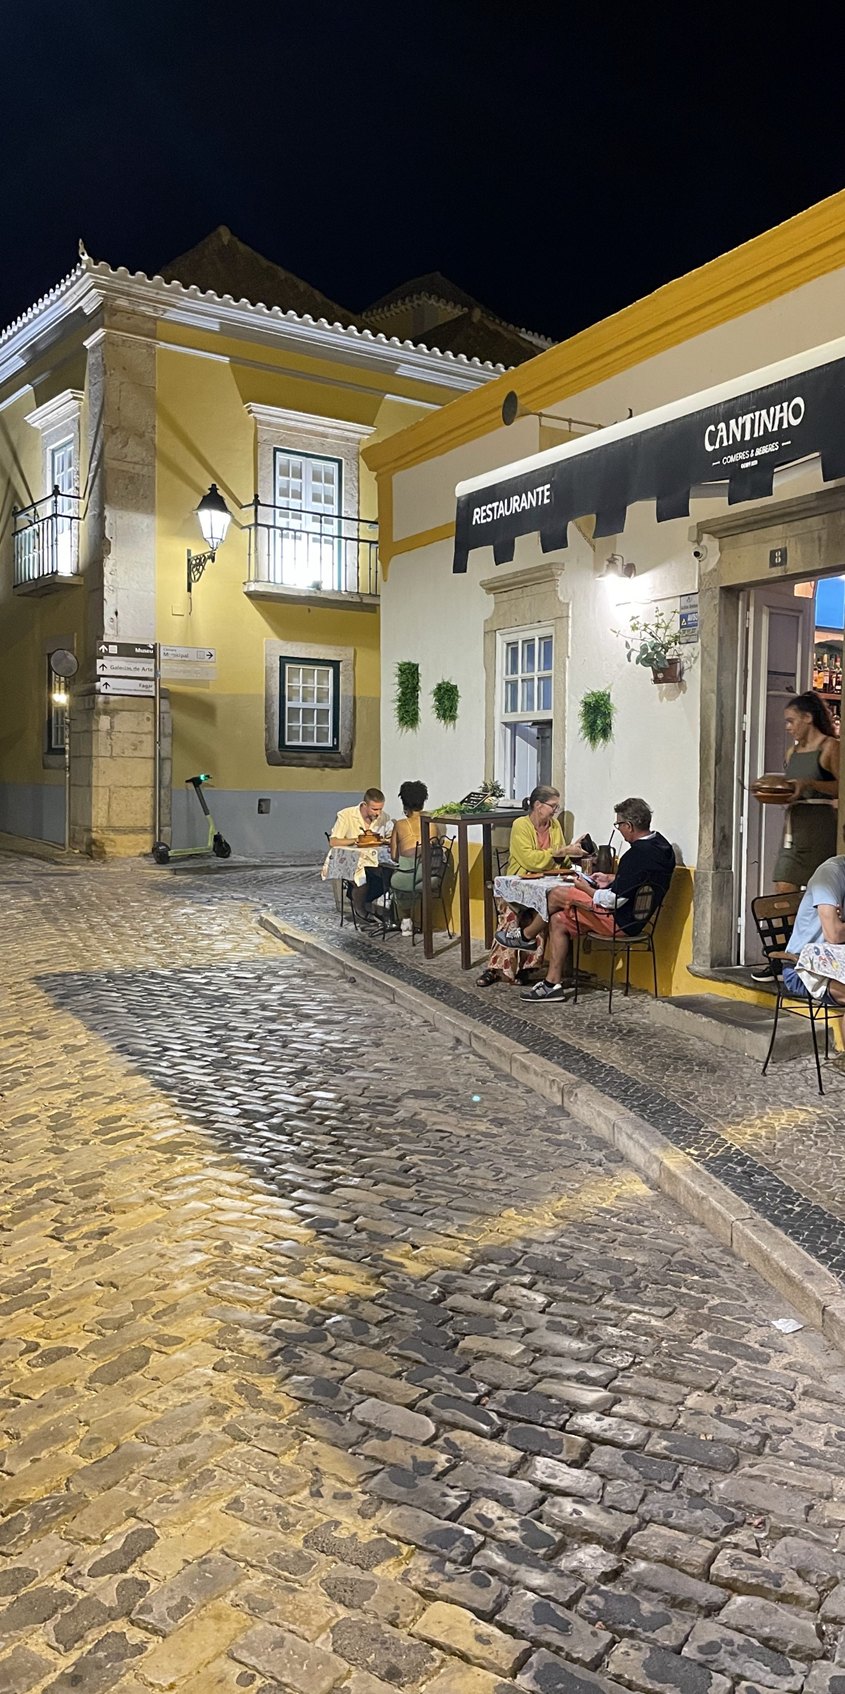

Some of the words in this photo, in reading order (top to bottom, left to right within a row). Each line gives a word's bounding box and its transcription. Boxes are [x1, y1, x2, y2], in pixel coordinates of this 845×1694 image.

[704, 397, 805, 452] CANTINHO
[722, 450, 750, 465] COMERES
[755, 441, 780, 457] BEBERES
[472, 483, 551, 526] RESTAURANTE
[775, 550, 782, 563] 8
